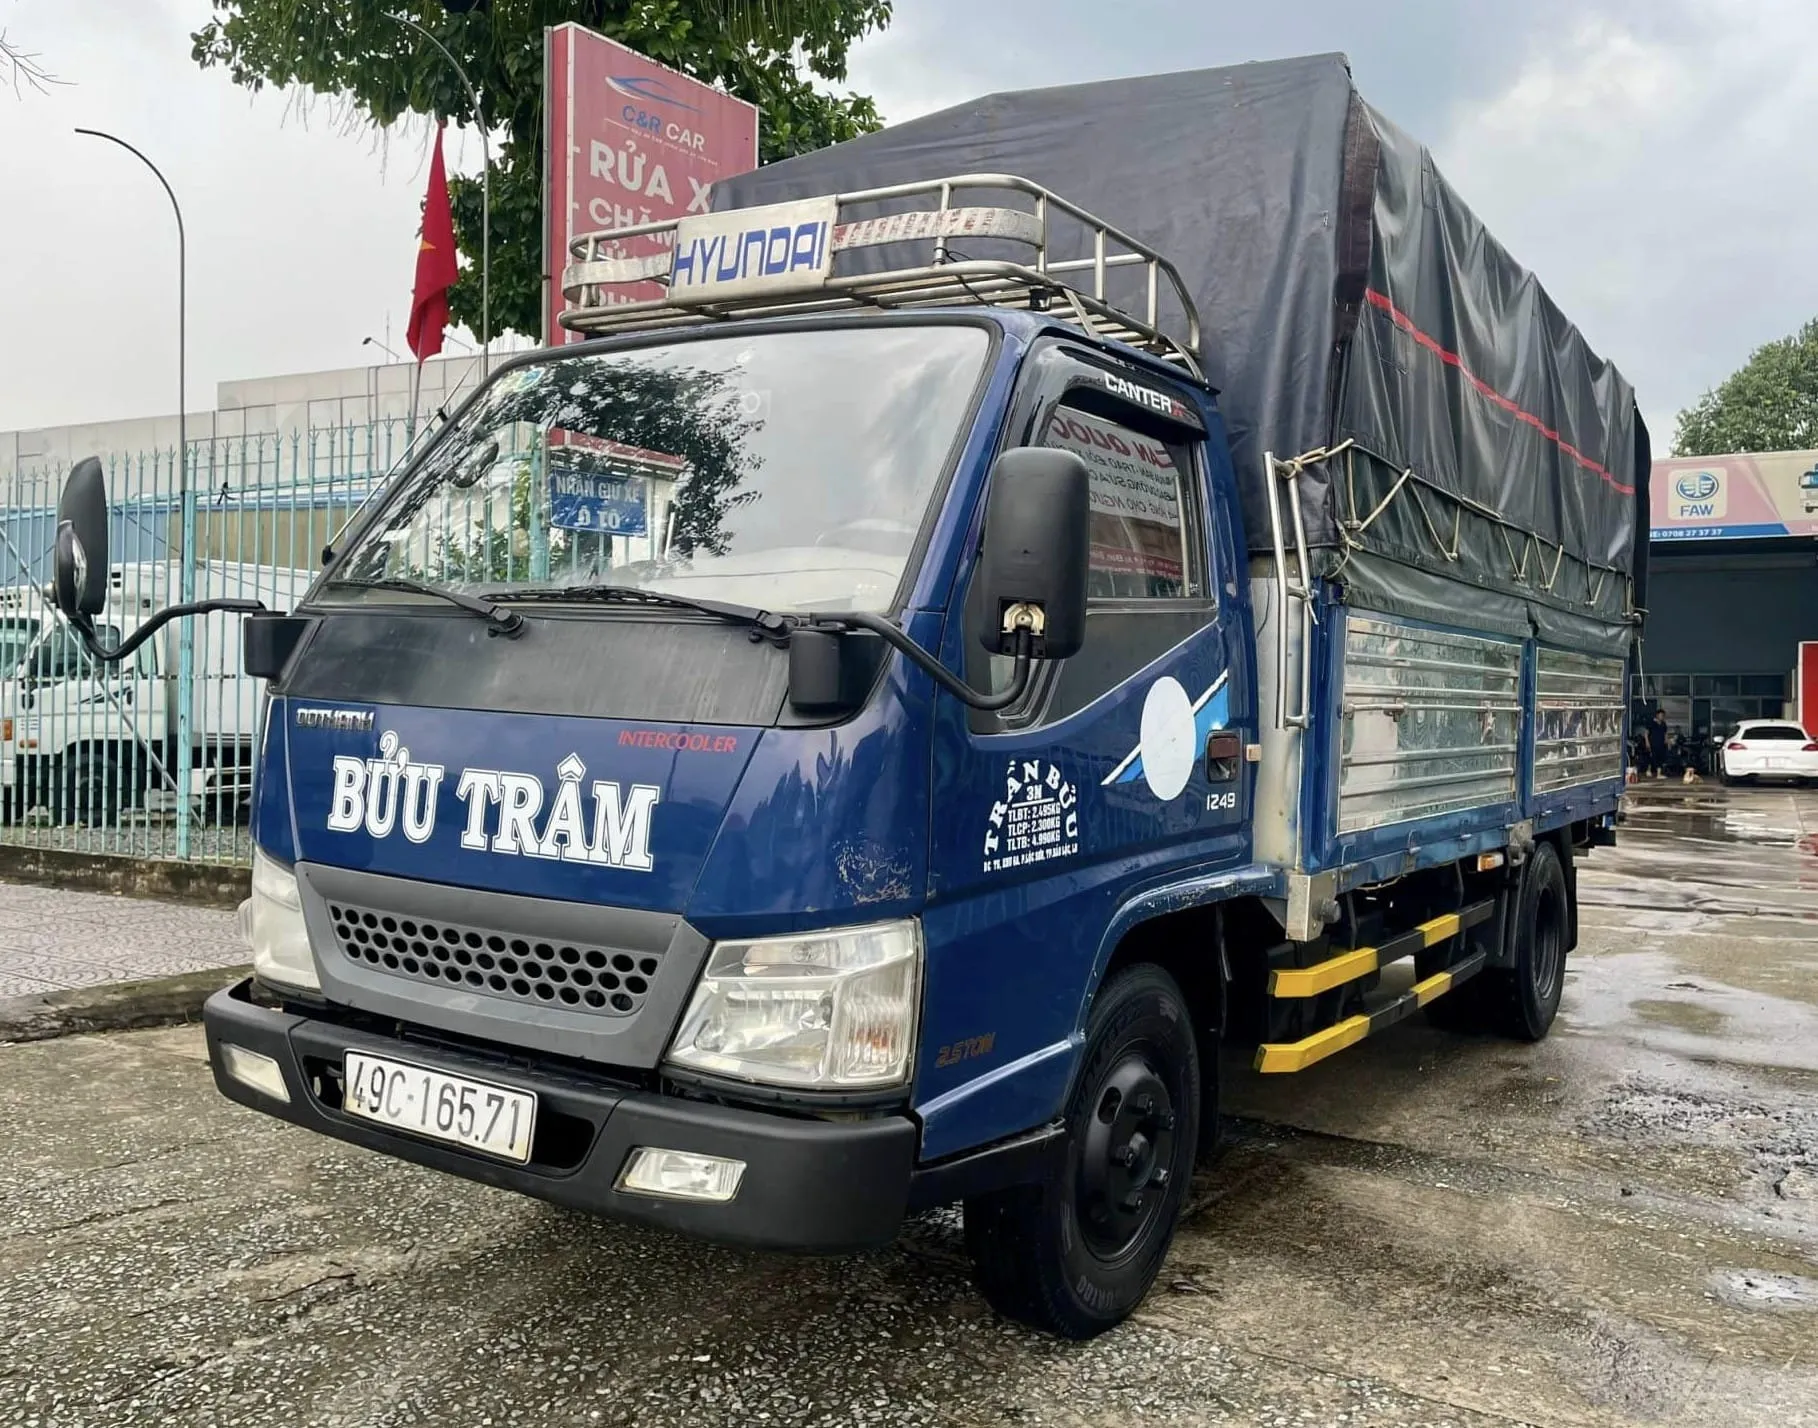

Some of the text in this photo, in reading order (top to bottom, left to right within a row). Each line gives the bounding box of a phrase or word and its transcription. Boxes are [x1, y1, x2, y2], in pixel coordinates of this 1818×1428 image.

[622, 105, 661, 134] C&R
[665, 122, 705, 151] CAR
[590, 139, 674, 205] RỬA
[671, 221, 828, 288] HYUNDAI
[1104, 372, 1172, 413] CANTER
[1680, 503, 1714, 517] FAW
[617, 730, 737, 753] INTERCOOLER
[328, 730, 660, 872] BỬU TRÂM
[1207, 792, 1236, 811] 1249
